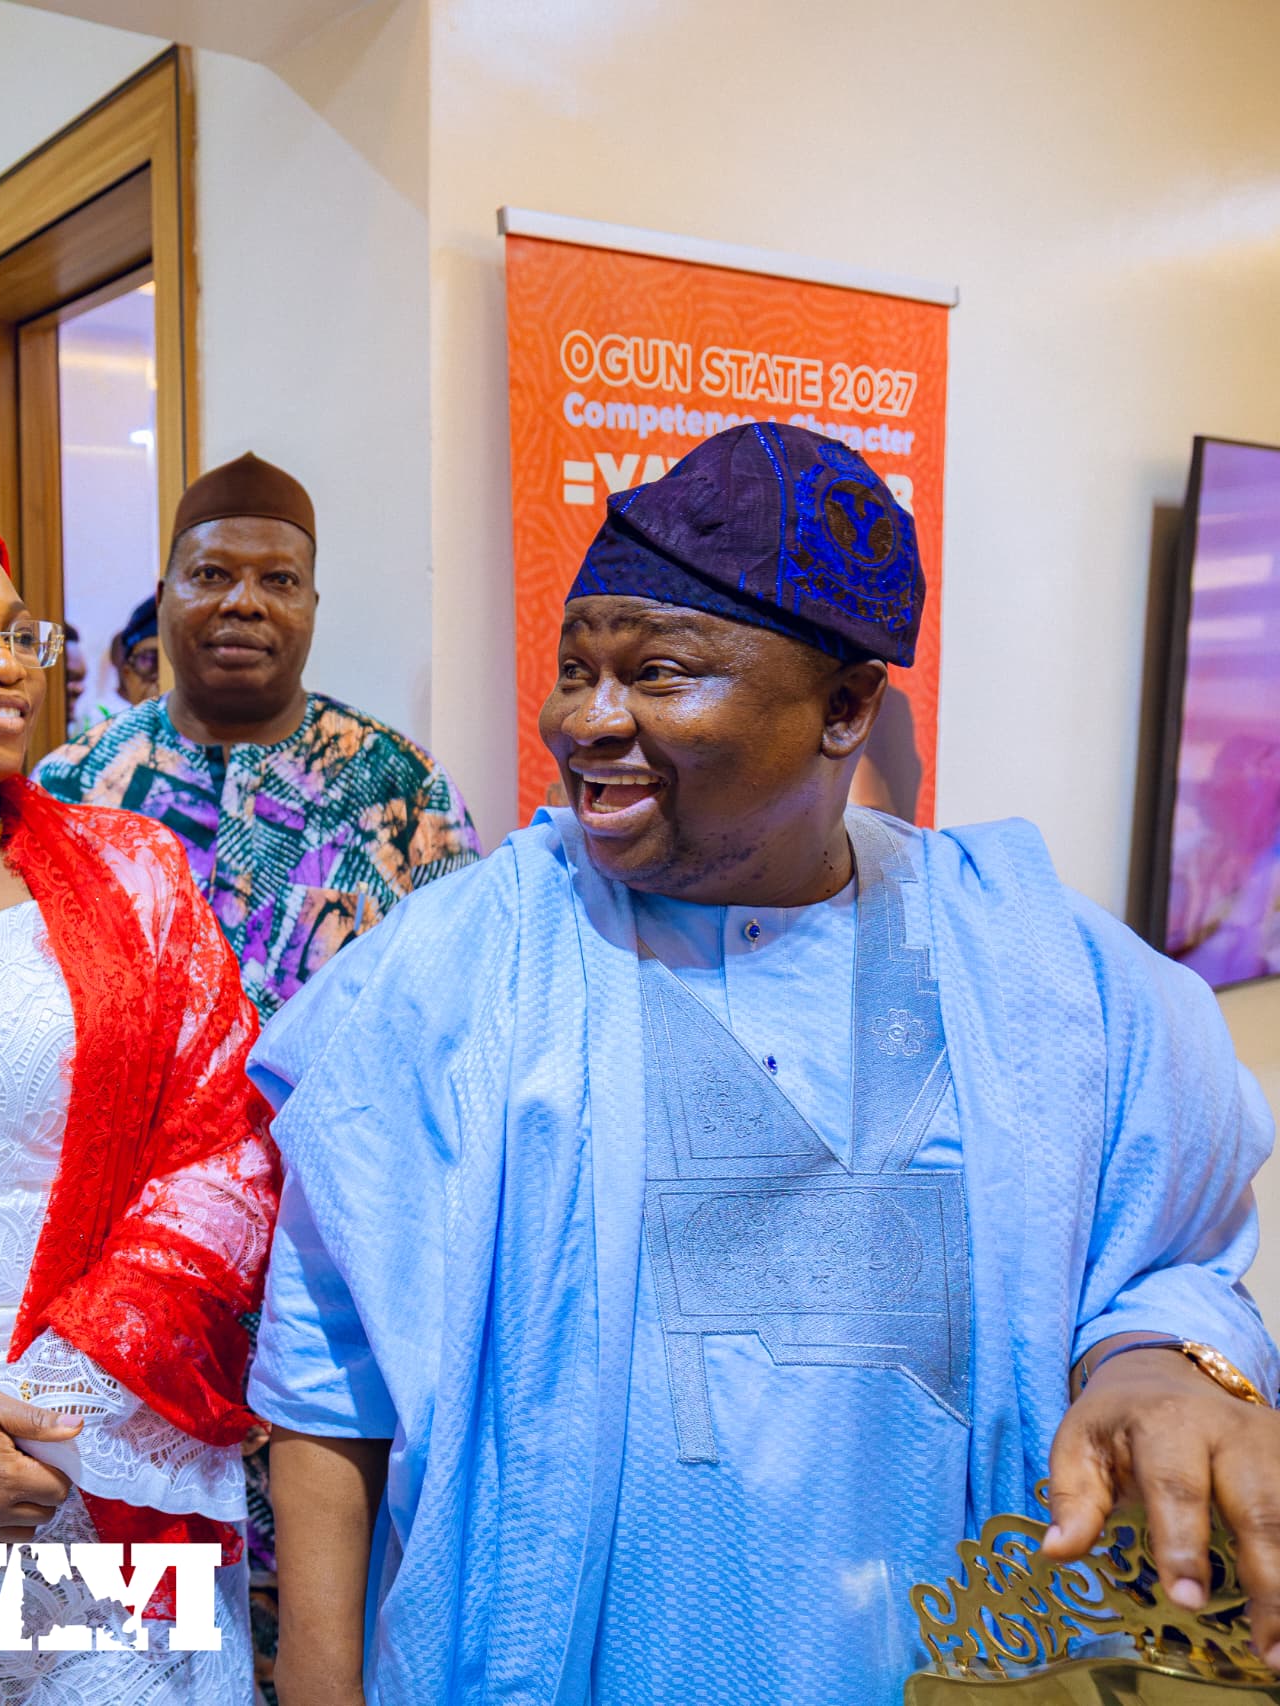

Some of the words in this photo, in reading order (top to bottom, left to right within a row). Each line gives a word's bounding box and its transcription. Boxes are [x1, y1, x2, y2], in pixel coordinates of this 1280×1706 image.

[560, 329, 692, 394] OGUN
[699, 346, 823, 407] STATE
[829, 362, 917, 417] 2027
